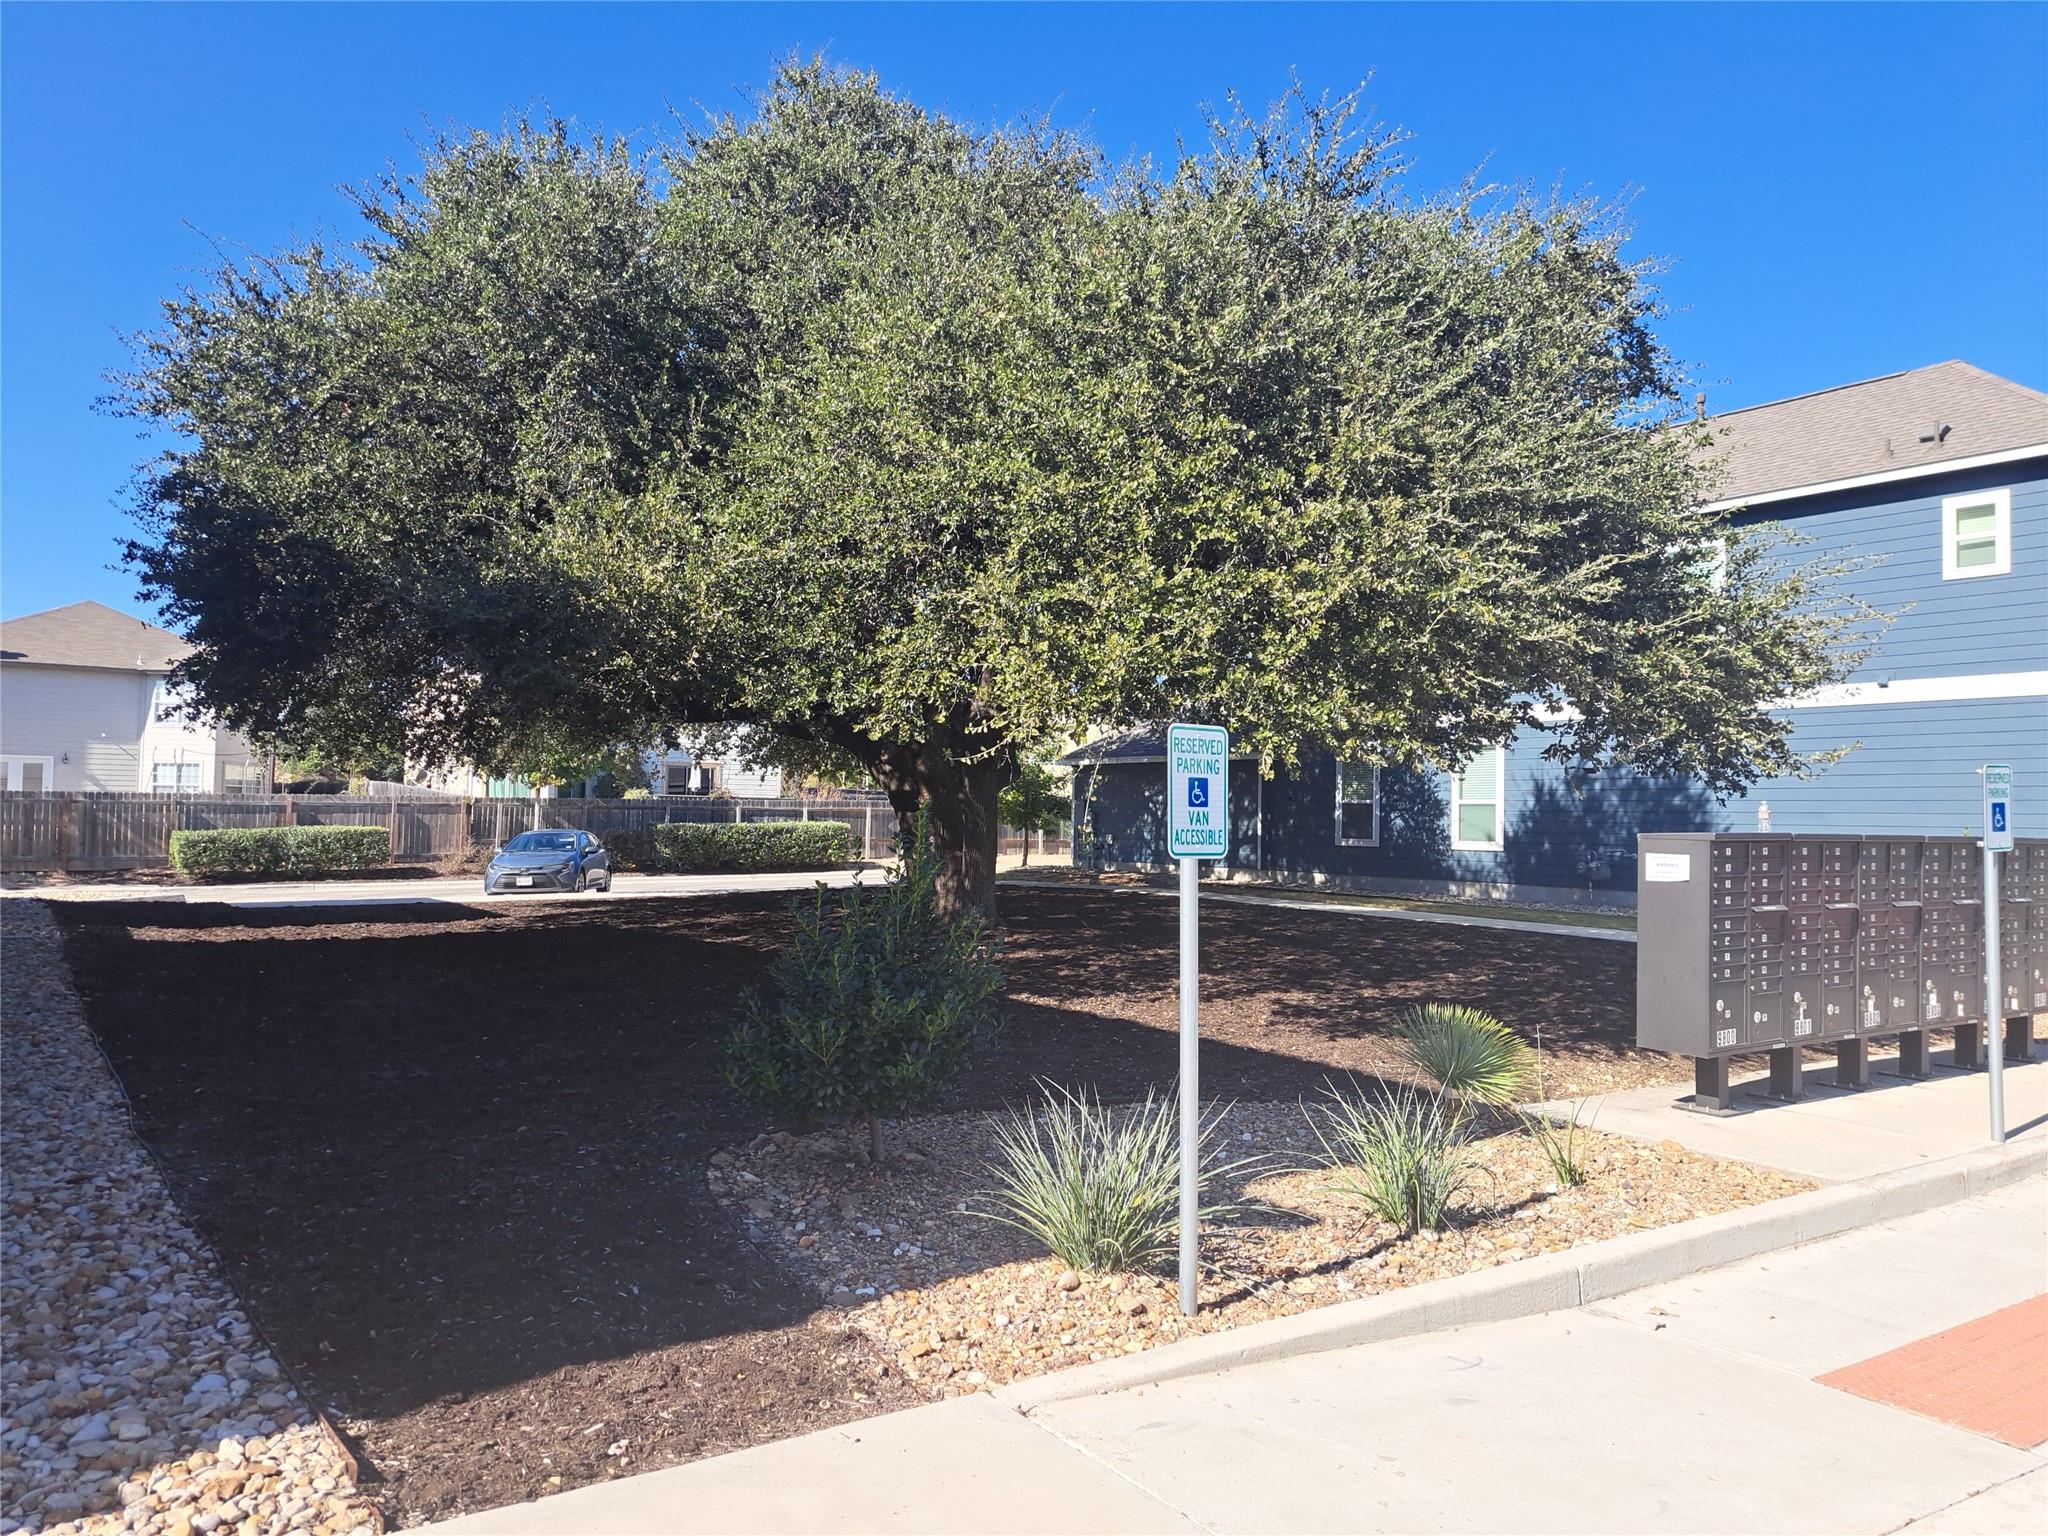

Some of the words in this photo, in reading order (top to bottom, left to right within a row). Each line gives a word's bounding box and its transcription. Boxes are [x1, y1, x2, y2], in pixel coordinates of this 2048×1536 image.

[1174, 736, 1223, 756] RESERVED
[1177, 757, 1220, 775] PARKING
[1188, 811, 1209, 826] VAN
[1175, 829, 1223, 846] ACCESSIBLE
[1717, 1029, 1736, 1047] 9800
